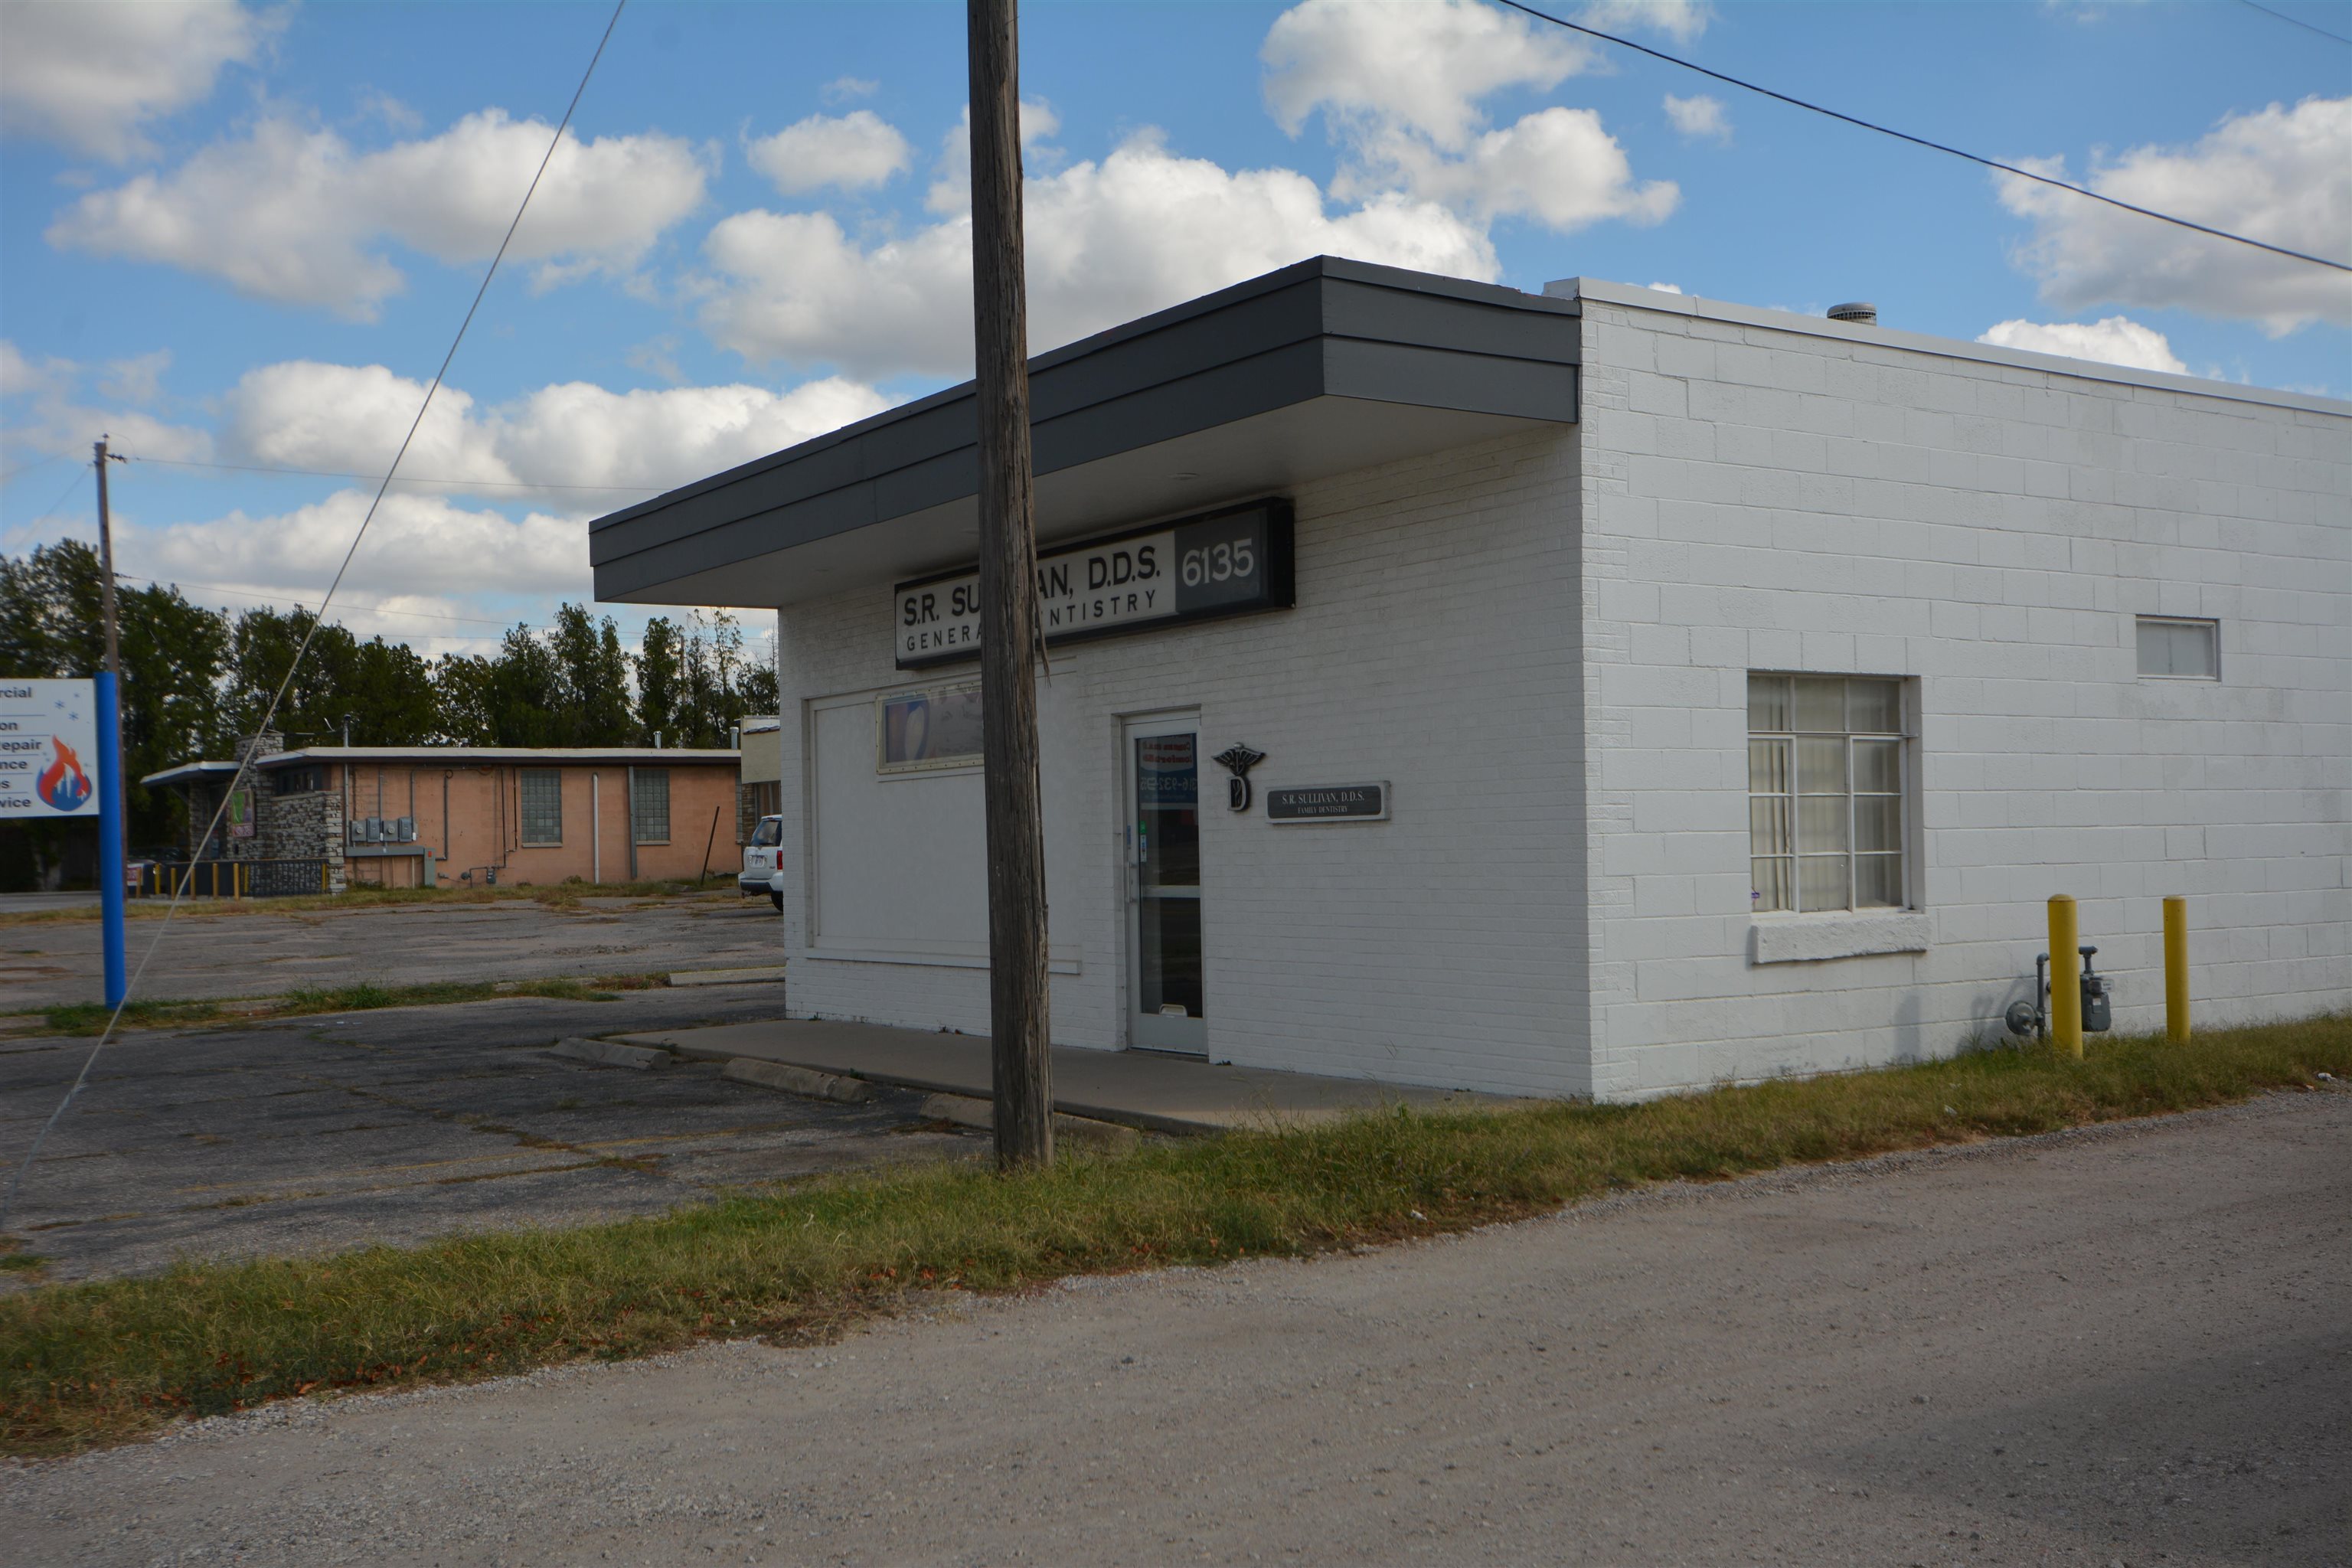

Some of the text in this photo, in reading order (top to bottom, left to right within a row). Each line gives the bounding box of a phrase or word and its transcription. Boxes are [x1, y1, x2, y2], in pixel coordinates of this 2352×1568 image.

[1181, 537, 1255, 587] 6135
[903, 546, 1161, 626] S.R. SUAN, D.D.S.
[906, 589, 1157, 652] GENER NTISTRY
[0, 739, 42, 753] epair
[1282, 790, 1364, 805] S.R. SULLIVAN, D.D.S.
[1298, 805, 1348, 815] FAMILY DENTISTRY
